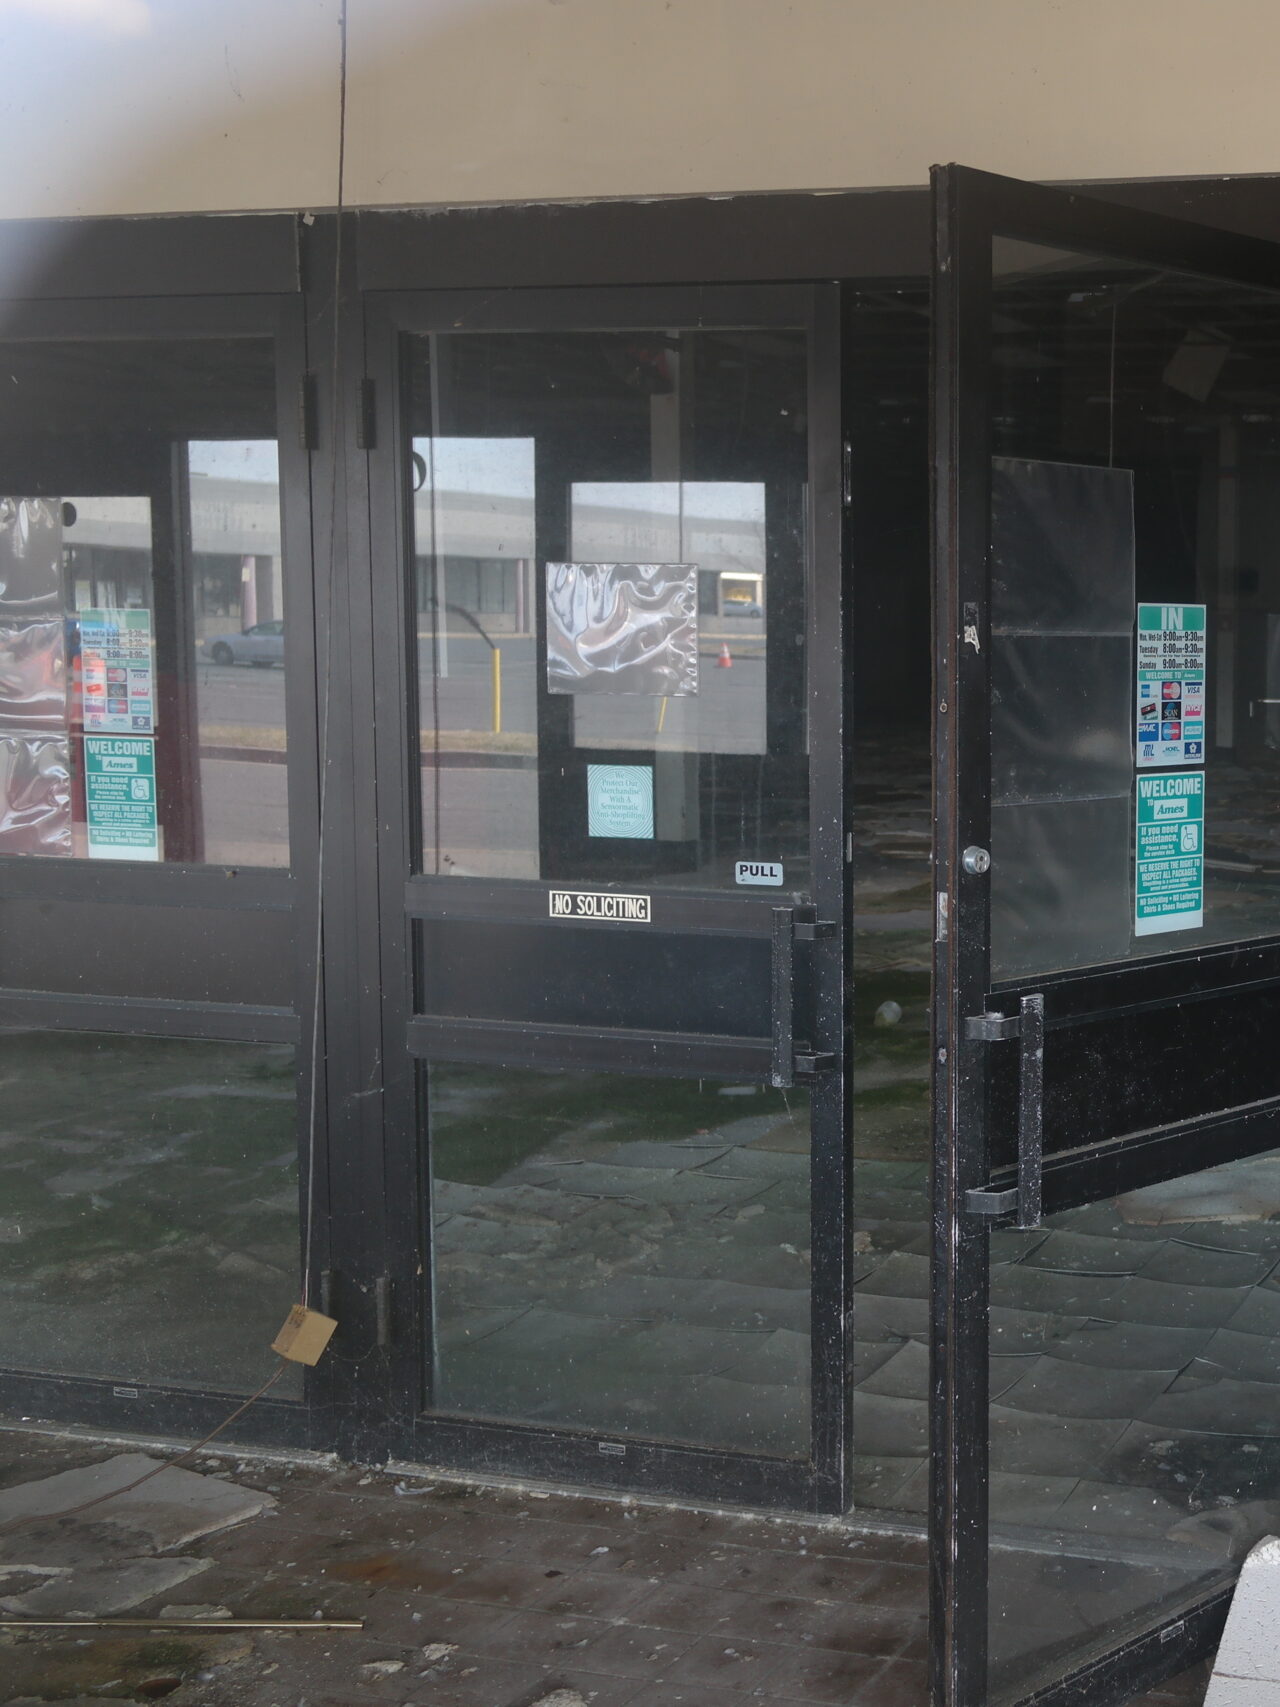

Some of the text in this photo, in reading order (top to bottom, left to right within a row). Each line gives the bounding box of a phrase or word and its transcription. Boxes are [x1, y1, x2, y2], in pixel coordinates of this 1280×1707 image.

[1161, 607, 1183, 631] IN
[1140, 645, 1158, 654] Tuesday
[1140, 661, 1157, 670] Sunday
[1146, 672, 1173, 680] WELCOME
[1188, 686, 1200, 694] VISA
[88, 740, 151, 756] WELCOME
[105, 760, 134, 768] Ames
[1140, 778, 1201, 798] WELCOME
[1148, 798, 1185, 816] TO Ames
[1142, 824, 1178, 836] If you need
[1141, 834, 1178, 844] assistance,
[740, 864, 778, 877] PULL
[1140, 858, 1200, 872] WE RESERVE THE RIGHT TO
[1142, 871, 1162, 881] INSPECT
[555, 894, 646, 918] NO SOLICITING
[1140, 898, 1146, 906] NO
[1148, 896, 1168, 905] Soliciting
[1162, 903, 1175, 911] Shoes
[1176, 900, 1195, 909] Required
